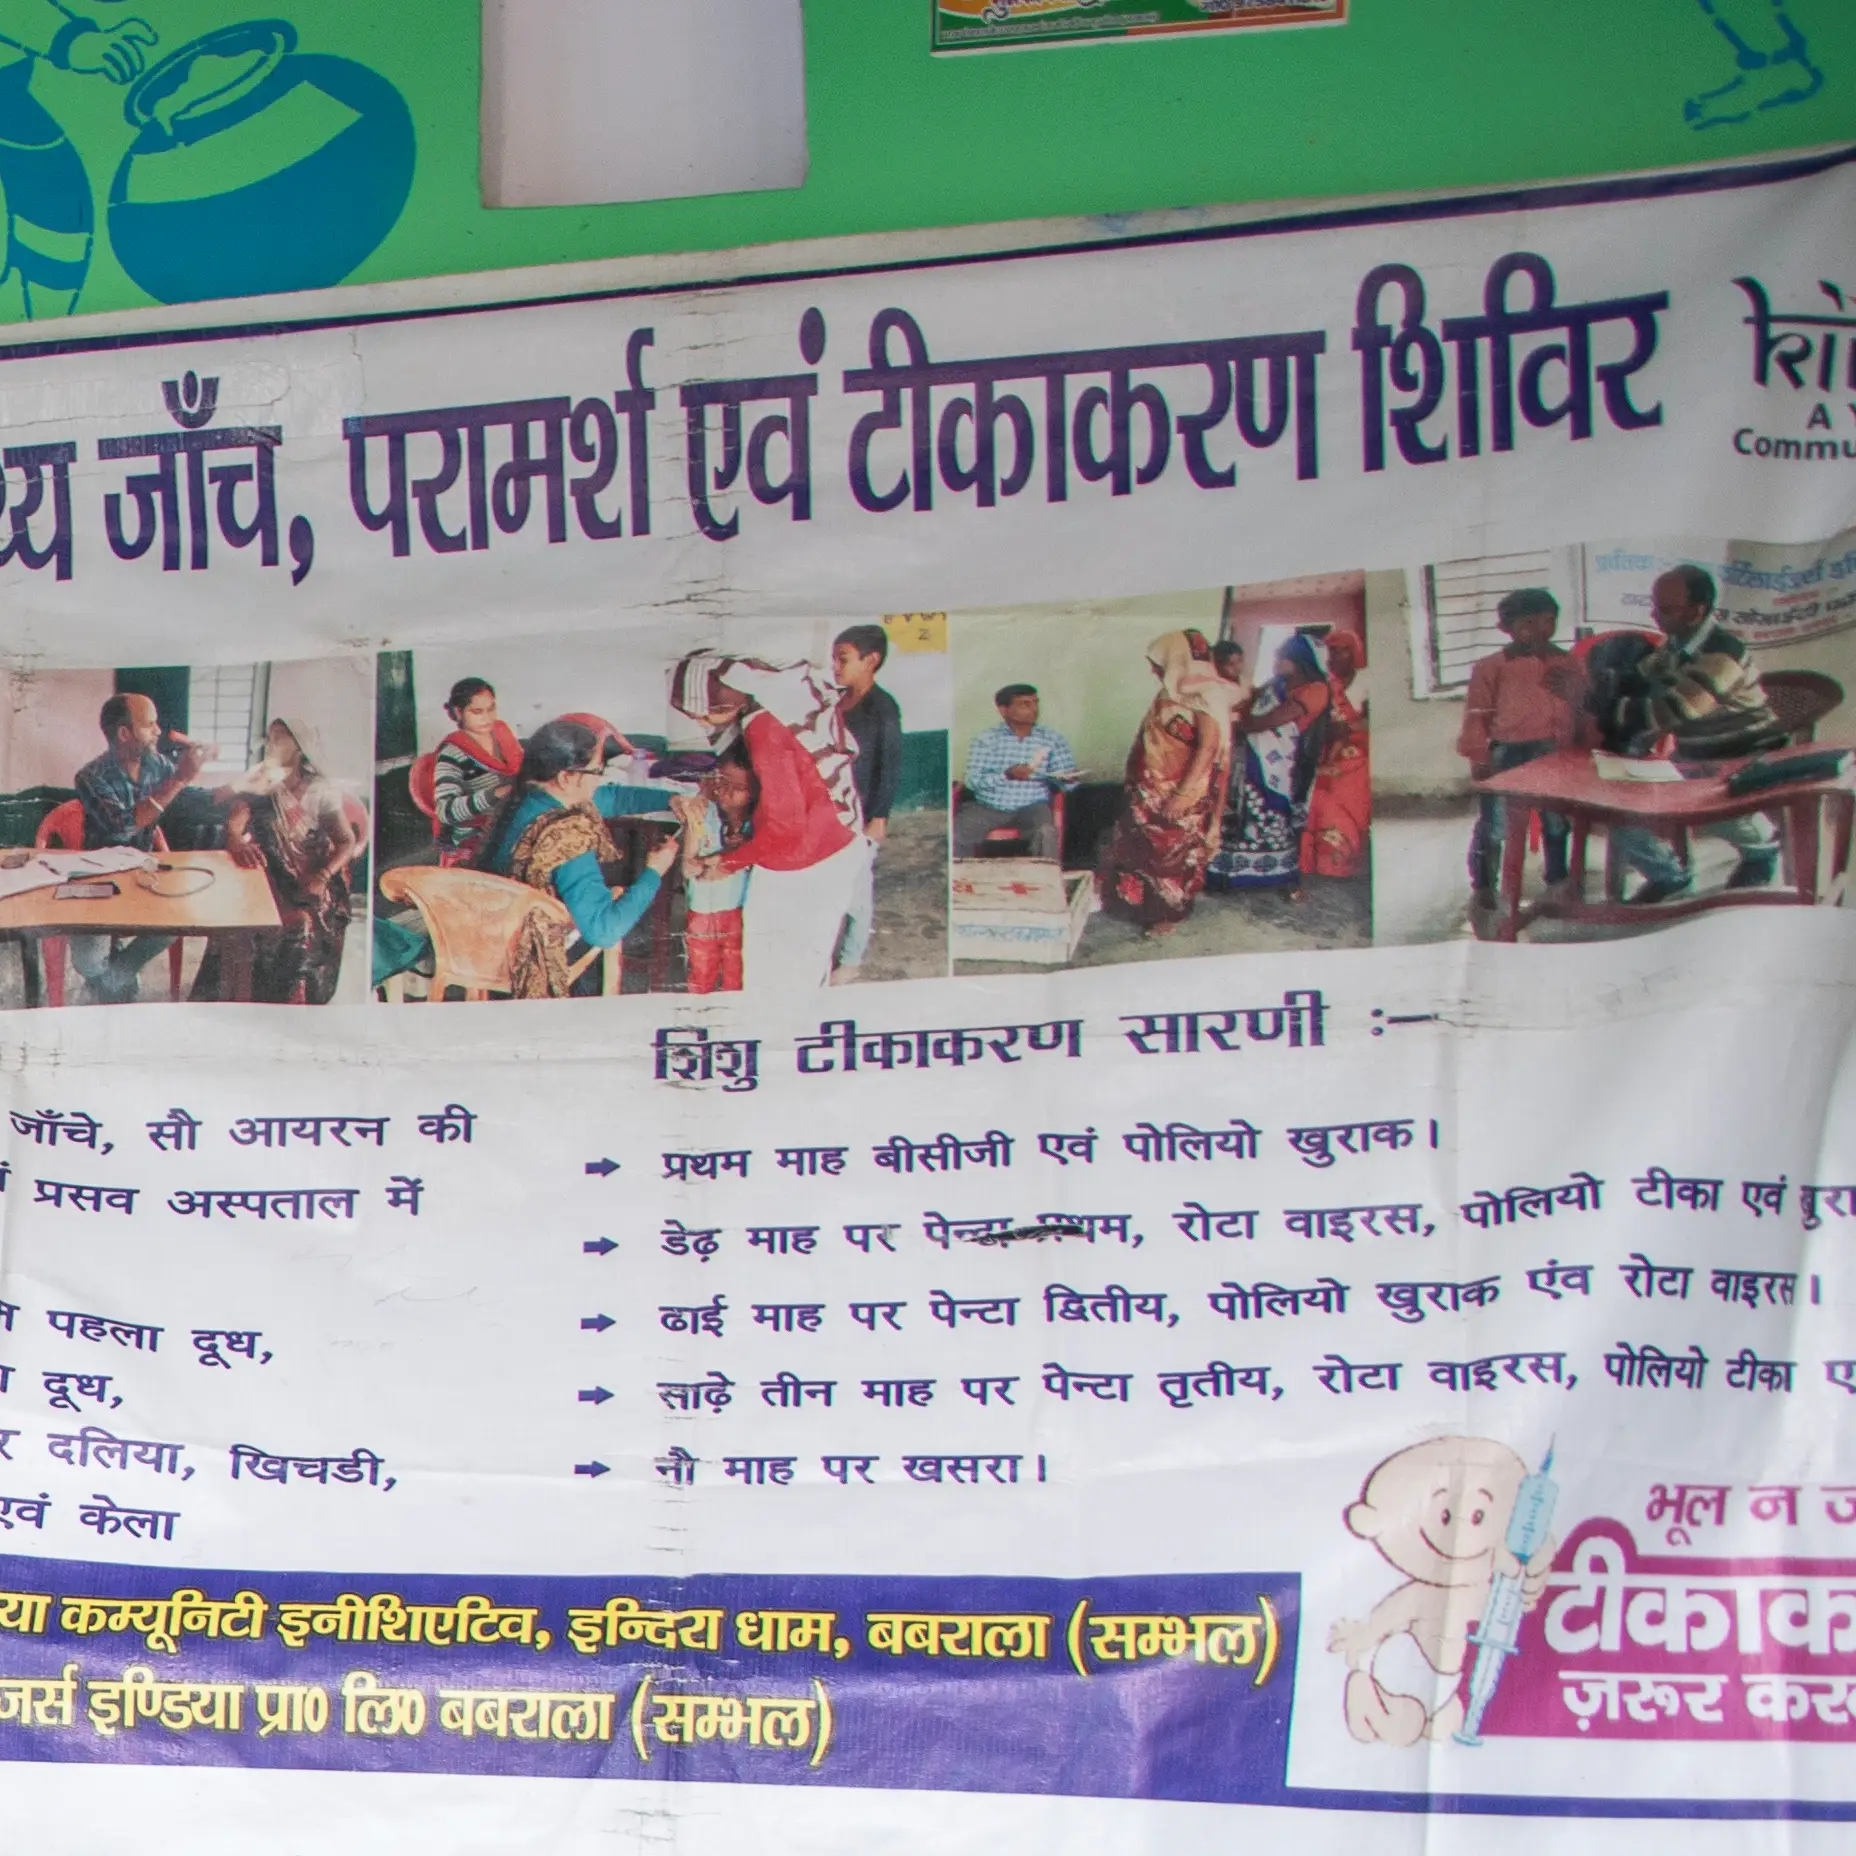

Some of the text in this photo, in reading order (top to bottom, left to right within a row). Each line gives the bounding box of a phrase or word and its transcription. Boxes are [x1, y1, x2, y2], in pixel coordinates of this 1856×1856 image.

[98, 371, 314, 586] जाँच,
[343, 329, 656, 557] परामर्श
[681, 307, 825, 541] एवं
[843, 308, 1325, 512] टीकाकरण
[1352, 252, 1670, 473] शिविर
[649, 1025, 762, 1093] शिशु
[793, 1019, 1085, 1074] टीकाकरण
[1118, 989, 1331, 1055] सारणी
[145, 1107, 204, 1152] सौ
[228, 1116, 392, 1148] आयरन
[416, 1103, 479, 1144] की
[660, 1149, 753, 1182] प्रथम
[774, 1146, 850, 1177] माह
[871, 1129, 1016, 1174] बीसीजी
[1036, 1126, 1099, 1167] एवं
[1121, 1118, 1263, 1163] पोलियो
[32, 1178, 141, 1216] प्रसव
[166, 1188, 361, 1221] अस्पताल
[384, 1175, 425, 1217] में
[659, 1218, 723, 1264] डेढ़
[745, 1225, 821, 1255] माह
[842, 1223, 902, 1254] पर
[1171, 1201, 1260, 1243] रोटा
[1282, 1203, 1436, 1244] वाइरस,
[1459, 1171, 1605, 1230] पोलियो
[1630, 1166, 1725, 1213] टीका
[1741, 1174, 1788, 1218] एवं
[657, 1293, 729, 1339] ढाई
[750, 1303, 827, 1333] माह
[847, 1301, 908, 1332] पर
[928, 1289, 1021, 1329] पेन्टा
[1206, 1276, 1352, 1321] पोलियो
[1374, 1275, 1501, 1324] खुराक
[1618, 1252, 1695, 1301] रोटा
[45, 1309, 166, 1353] पहला
[190, 1329, 274, 1370] दूध,
[41, 1371, 124, 1413] दूध,
[759, 1370, 839, 1408] तीन
[860, 1378, 938, 1408] माह
[959, 1375, 1021, 1407] पर
[1041, 1361, 1135, 1403] पेन्टा
[1311, 1353, 1404, 1395] रोटा
[1426, 1352, 1578, 1392] वाइरस,
[1603, 1341, 1710, 1390] पोलियो
[1724, 1347, 1797, 1393] टीका
[46, 1425, 196, 1482] दलिया,
[654, 1445, 701, 1486] नौ
[721, 1456, 799, 1486] माह
[820, 1455, 881, 1485] पर
[78, 1493, 182, 1542] केला
[1646, 1483, 1732, 1546] भूल
[1748, 1485, 1802, 1526] न
[60, 1588, 269, 1654] कम्यूनिटी
[565, 1596, 723, 1657] इन्दिरा
[734, 1606, 852, 1661] धाम,
[866, 1612, 1052, 1661] बबराला
[1066, 1596, 1281, 1687] (सम्भल)
[439, 1688, 614, 1741] बबराला
[629, 1673, 836, 1767] (सम्भल)
[1740, 1673, 1856, 1724] कर
